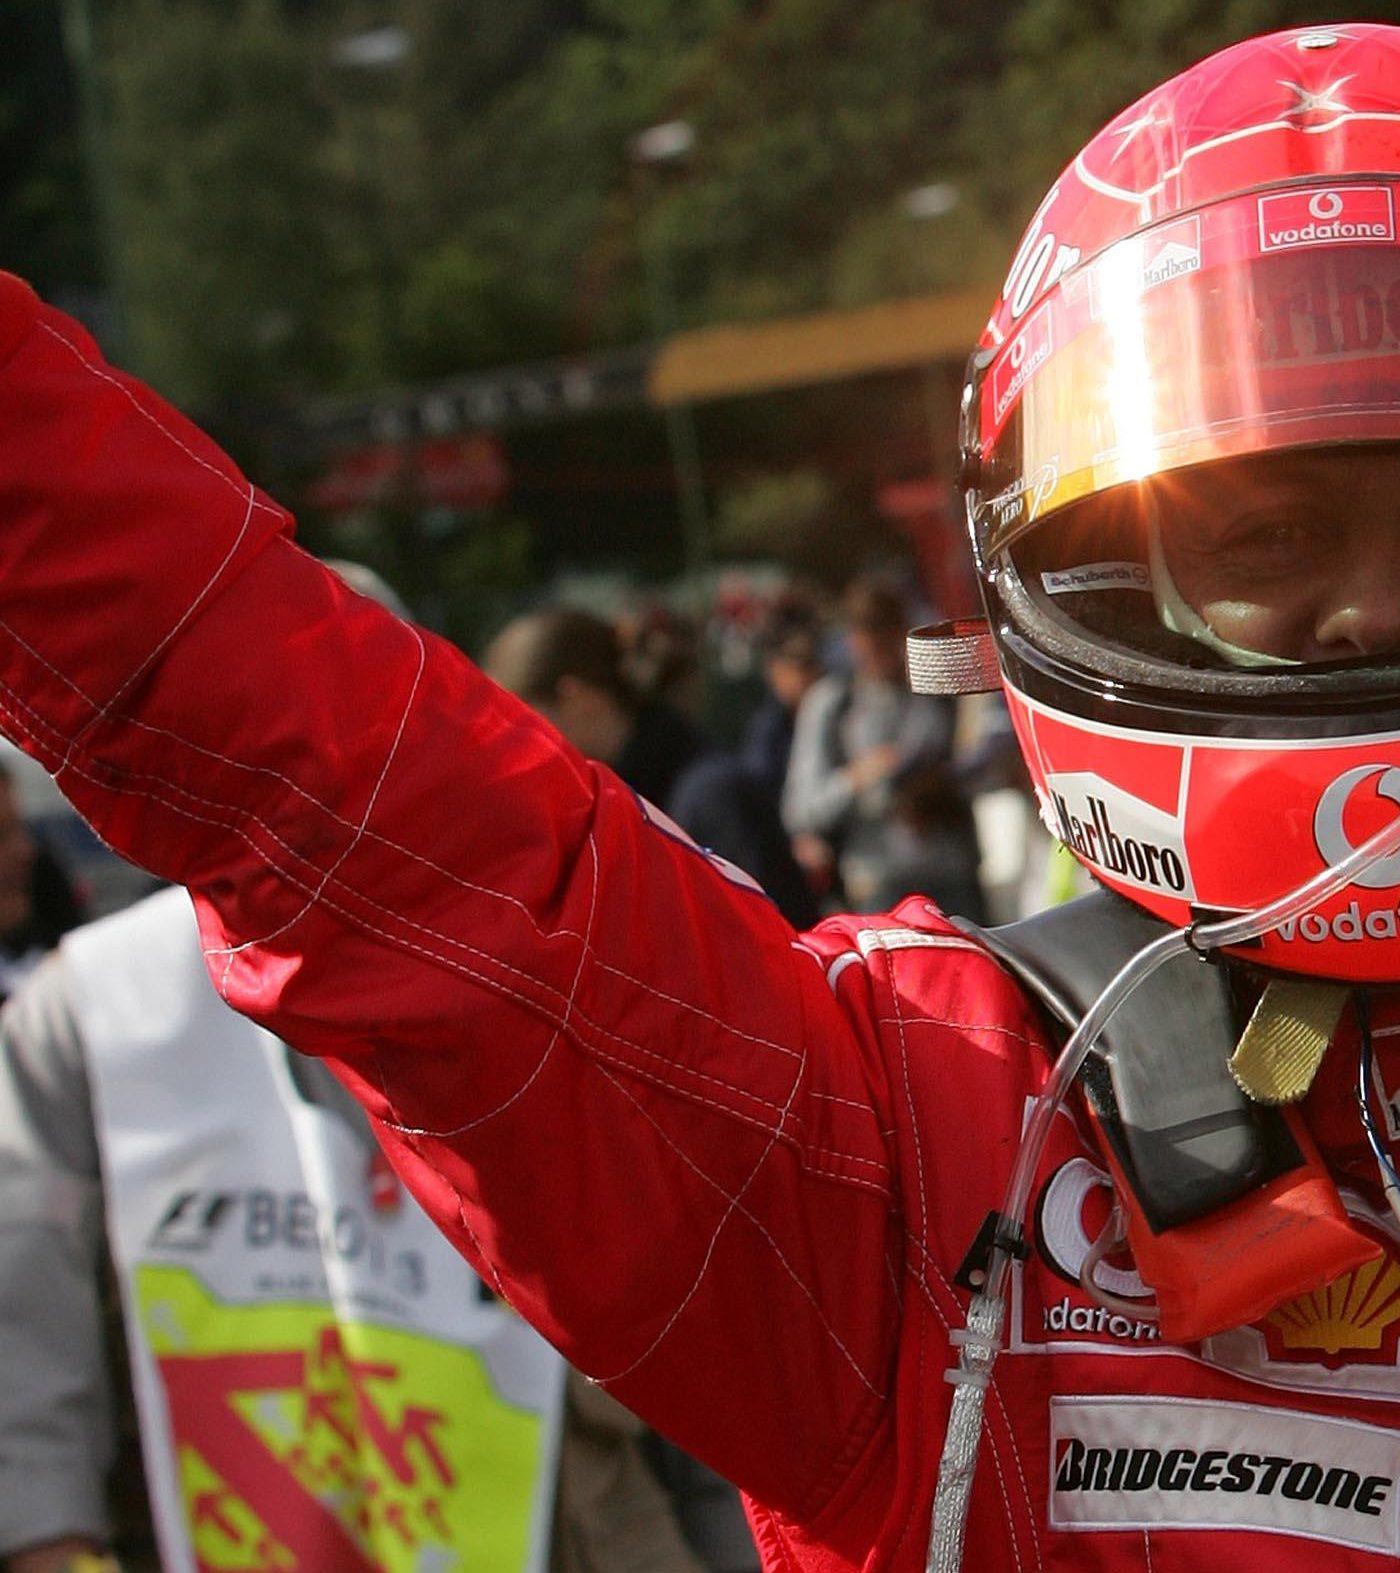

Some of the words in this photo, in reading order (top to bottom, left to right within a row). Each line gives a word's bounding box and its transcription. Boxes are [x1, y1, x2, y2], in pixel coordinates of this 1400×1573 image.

[1270, 219, 1387, 246] vodafone
[1050, 788, 1186, 892] Marlboro
[1043, 1296, 1163, 1341] dafon
[1055, 1437, 1393, 1516] BRIDGESTONE
